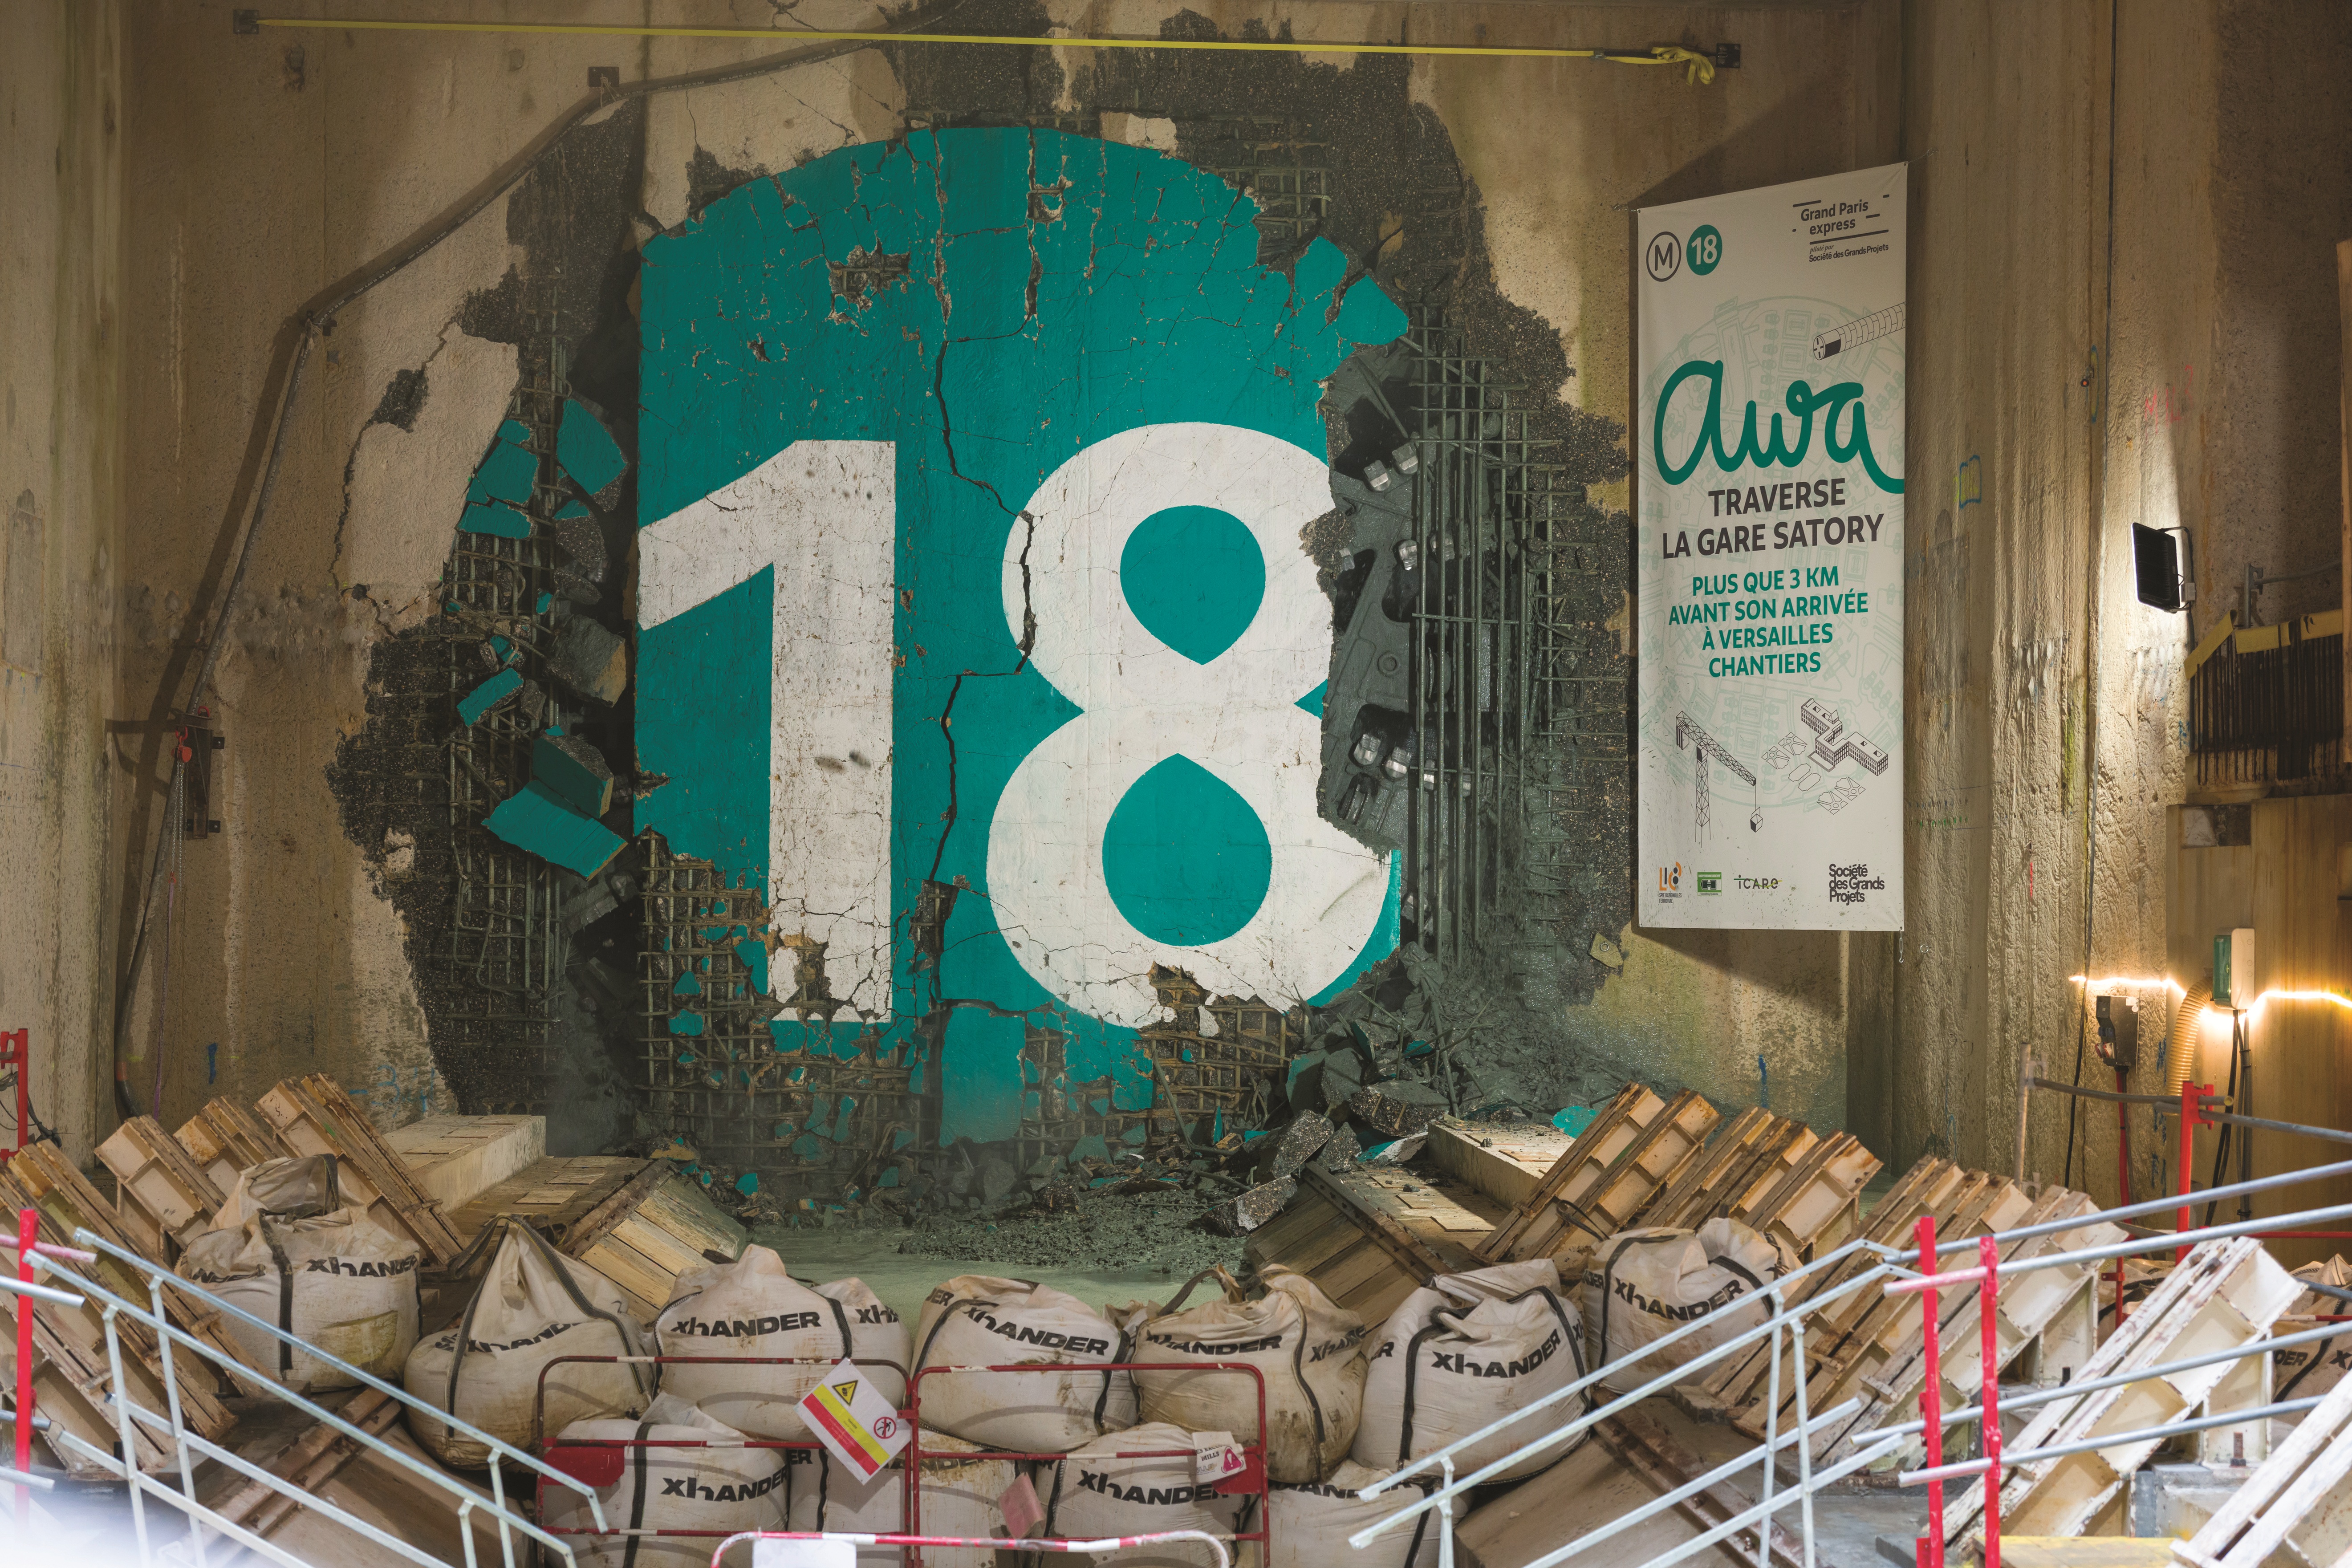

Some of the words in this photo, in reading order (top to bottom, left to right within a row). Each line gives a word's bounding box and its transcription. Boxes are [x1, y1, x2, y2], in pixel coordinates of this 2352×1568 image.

[1801, 203, 1836, 221] Grand
[1839, 199, 1869, 215] Paris
[1809, 219, 1856, 236] express
[1654, 242, 1673, 271] M
[1691, 234, 1718, 265] 18
[1809, 245, 1824, 254] piloté
[1809, 251, 1832, 262] Société
[1833, 250, 1844, 259] des
[1844, 247, 1866, 257] Grands
[1866, 243, 1889, 254] Projets
[1708, 478, 1846, 517] TRAVERSE
[1663, 531, 1691, 559] LA
[1697, 524, 1766, 556] GARE
[1773, 513, 1885, 550] SATORY
[1692, 573, 1738, 596] PLUS
[1743, 570, 1784, 593] QUE
[1789, 569, 1800, 589] 3
[1806, 566, 1839, 587] KM
[1668, 601, 1730, 626] AVANT
[1735, 598, 1776, 621] SON
[1782, 588, 1869, 618] ARRIVÉE
[1702, 627, 1716, 650] À
[1719, 623, 1833, 649] VERSAILLES
[1708, 652, 1821, 678] CHANTIERS
[638, 422, 1391, 1028] 18
[1829, 864, 1868, 877] Société
[1829, 876, 1848, 890] des
[1849, 876, 1885, 890] Grands
[1829, 889, 1865, 906] Projets
[1201, 1451, 1220, 1462] MILLS
